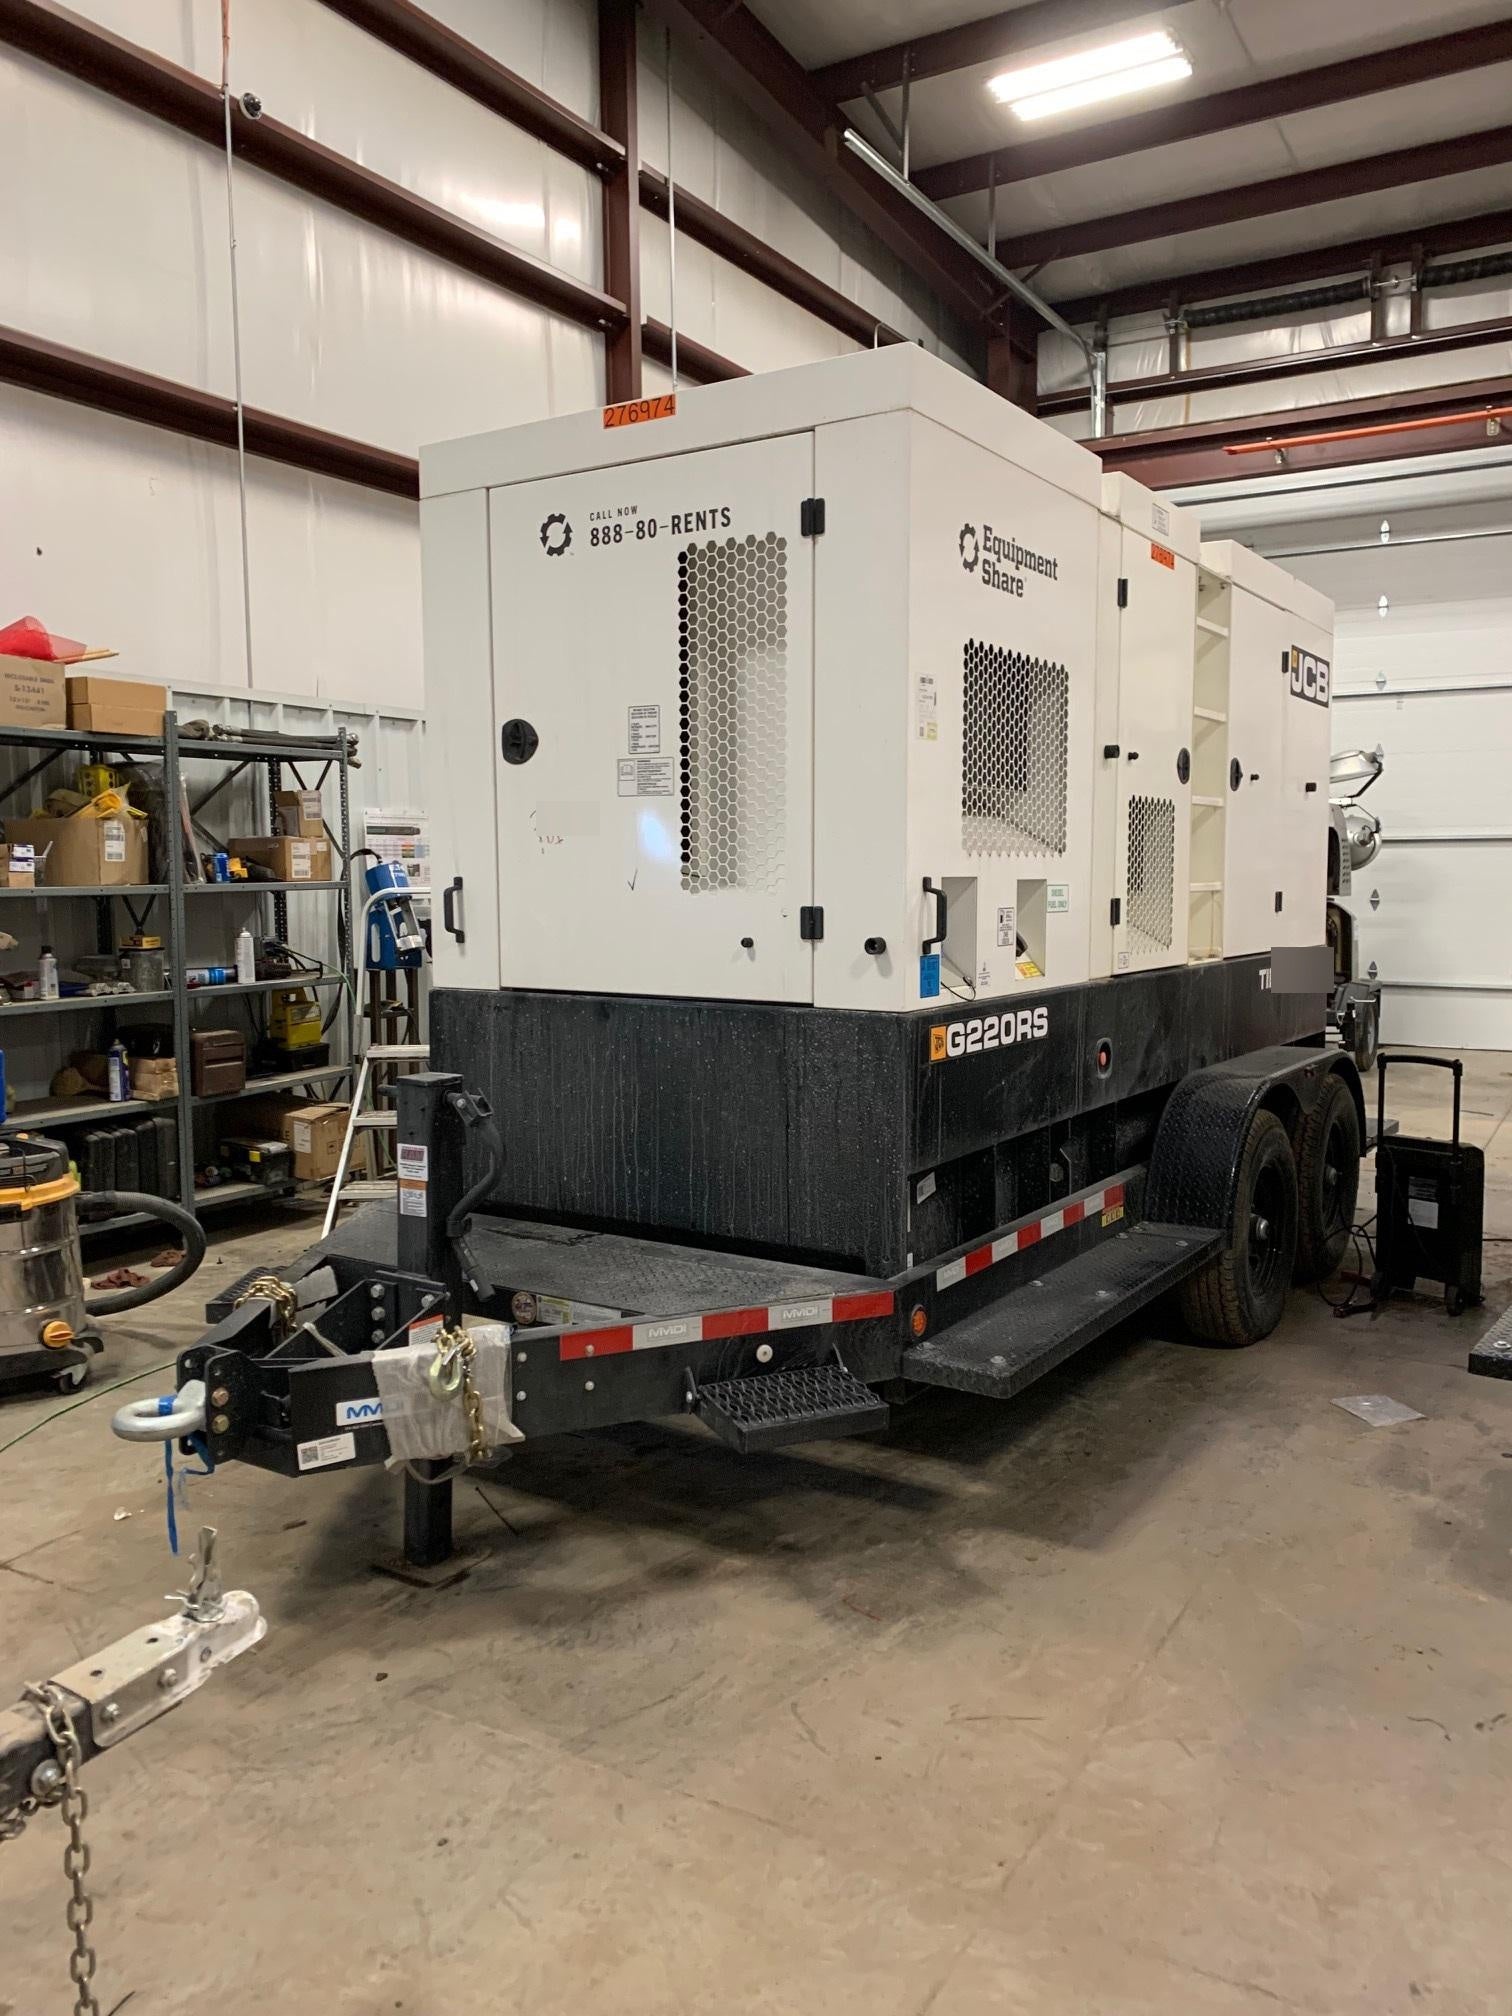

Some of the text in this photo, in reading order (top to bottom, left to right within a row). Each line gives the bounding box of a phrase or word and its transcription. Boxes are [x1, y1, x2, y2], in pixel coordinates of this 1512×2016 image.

[604, 395, 675, 427] 276974
[590, 505, 638, 521] CALL NOW
[590, 506, 731, 547] 888-80-RENTS
[983, 524, 1058, 580] Equipment
[982, 558, 1024, 598] Share
[1291, 652, 1329, 702] JCB
[947, 1007, 1048, 1057] G220RS
